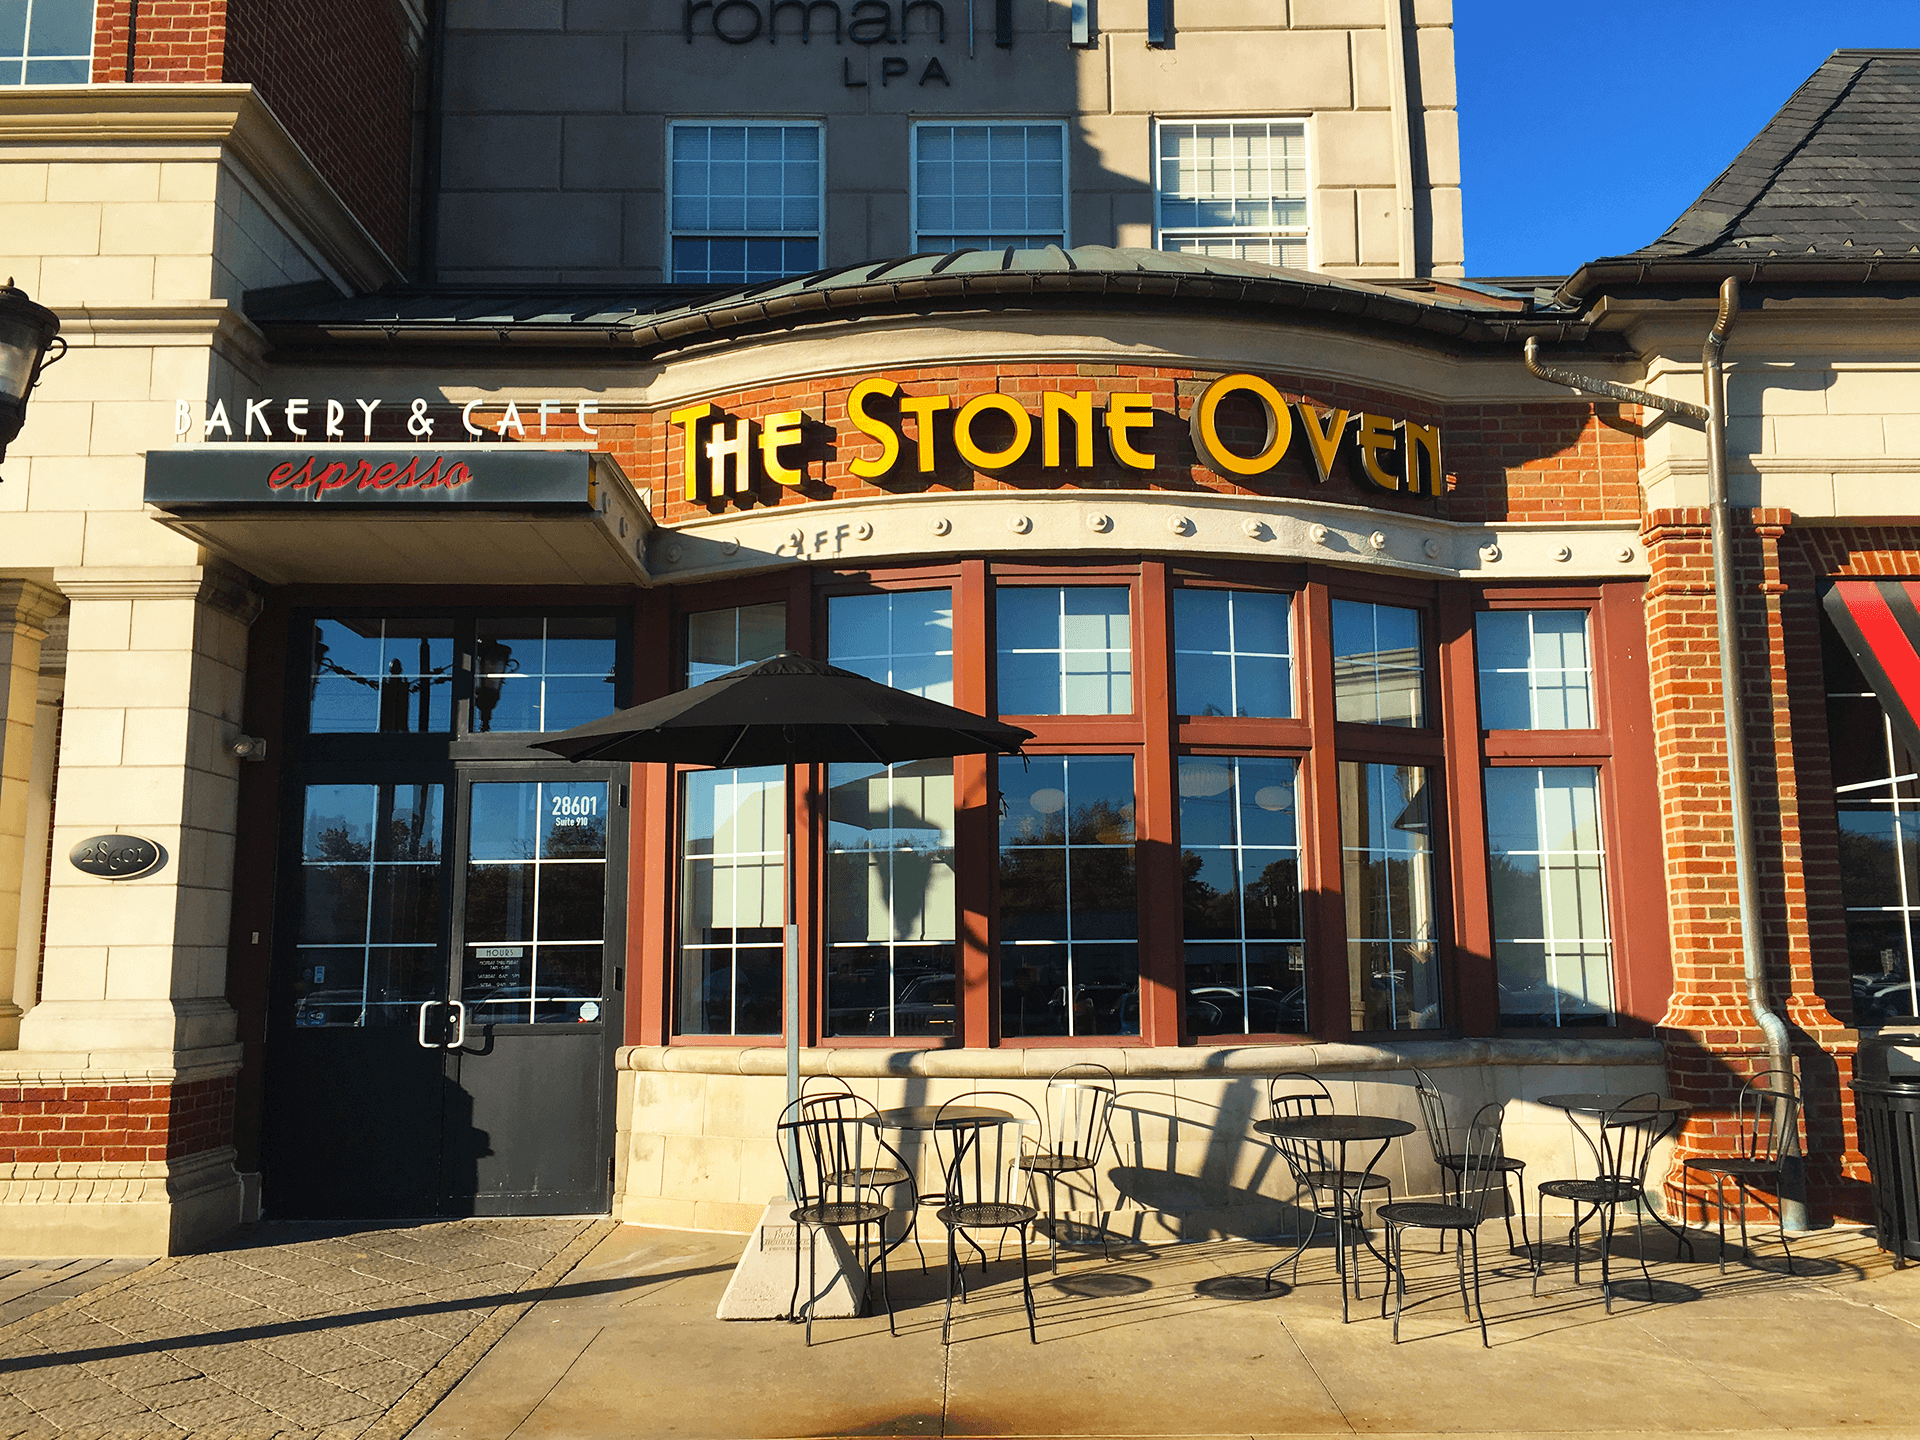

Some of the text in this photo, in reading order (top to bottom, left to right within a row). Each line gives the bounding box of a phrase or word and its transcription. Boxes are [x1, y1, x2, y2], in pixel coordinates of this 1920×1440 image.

[174, 398, 599, 437] BAKERY & CAFE
[670, 373, 1446, 503] THE STONE OVEN
[268, 455, 472, 500] espresso
[551, 796, 597, 815] 28601
[555, 817, 588, 826] Suite 910
[81, 840, 143, 871] 28601
